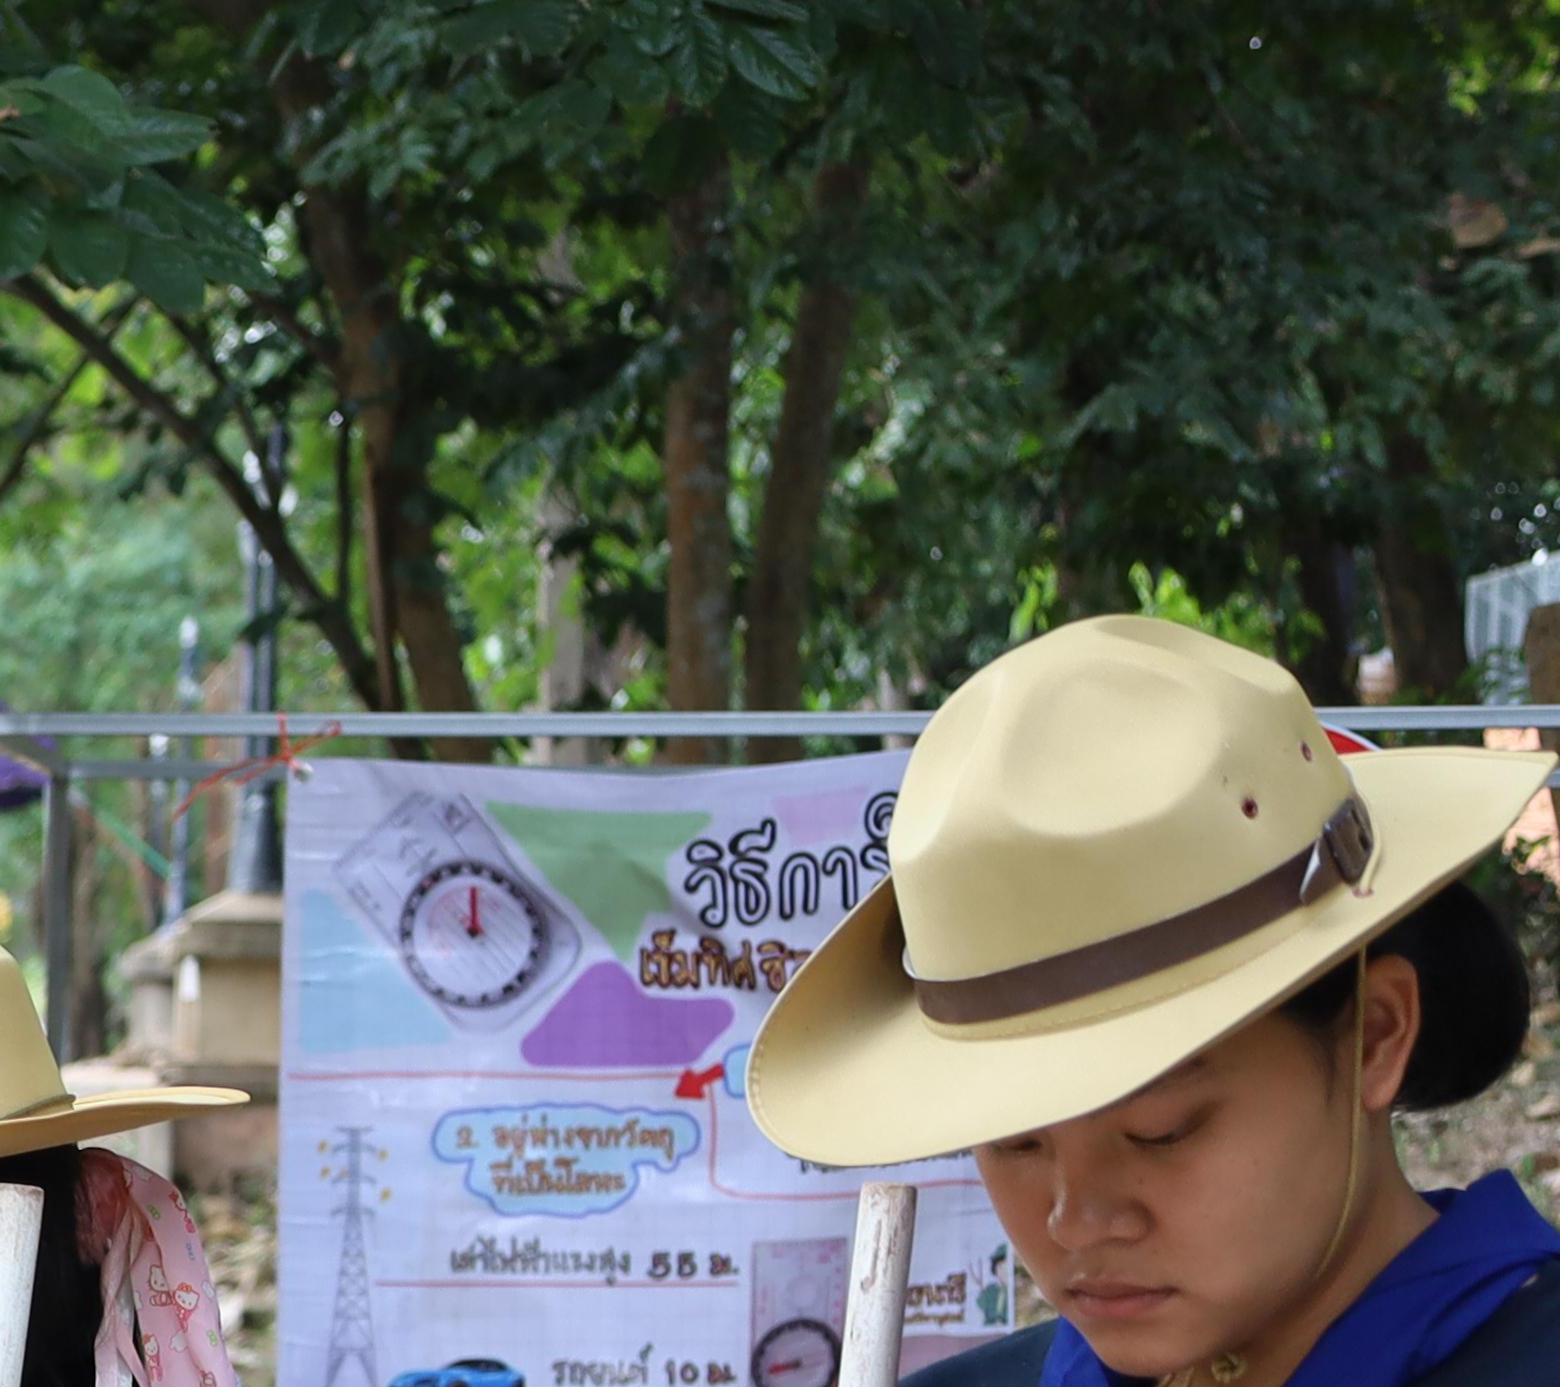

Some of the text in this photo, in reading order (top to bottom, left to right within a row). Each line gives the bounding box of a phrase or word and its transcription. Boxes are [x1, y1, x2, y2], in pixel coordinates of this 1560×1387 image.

[647, 1252, 697, 1279] 55
[551, 1342, 654, 1387] รถยนต์
[665, 1359, 700, 1386] 10
